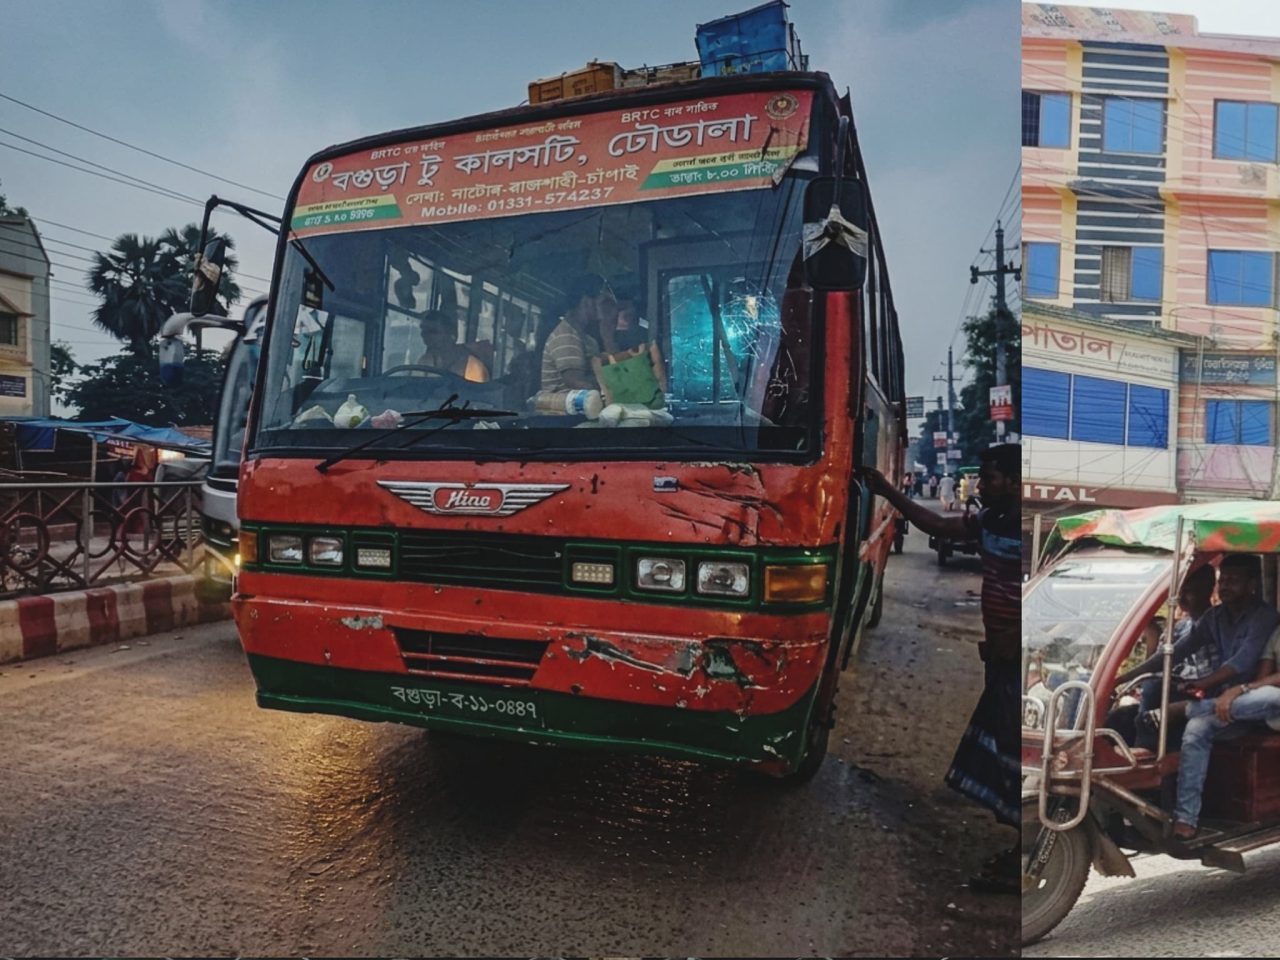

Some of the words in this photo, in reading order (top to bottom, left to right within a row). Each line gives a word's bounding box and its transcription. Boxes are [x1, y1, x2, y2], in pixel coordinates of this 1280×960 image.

[620, 109, 660, 123] BRTC
[417, 154, 445, 187] টু
[487, 186, 615, 211] 01331-574237
[1023, 484, 1096, 502] ITAL
